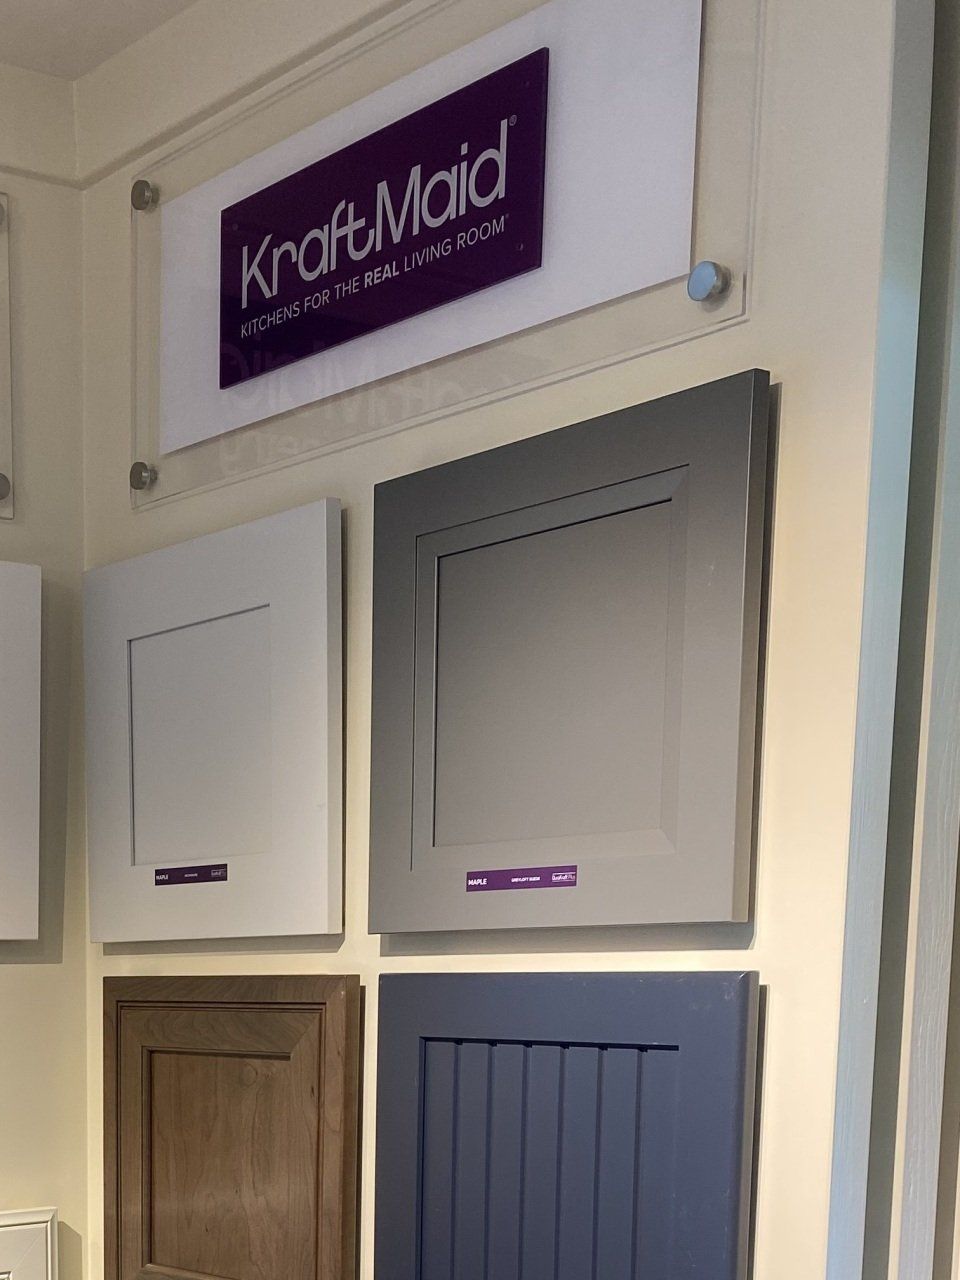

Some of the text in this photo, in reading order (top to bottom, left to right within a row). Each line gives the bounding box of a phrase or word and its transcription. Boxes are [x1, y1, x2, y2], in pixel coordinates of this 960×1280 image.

[241, 301, 300, 339] KITCHENS
[304, 289, 330, 313] FOR
[334, 276, 360, 299] THE
[364, 261, 400, 288] REAL
[404, 238, 452, 272] LIVING
[468, 878, 487, 886] MAPLE
